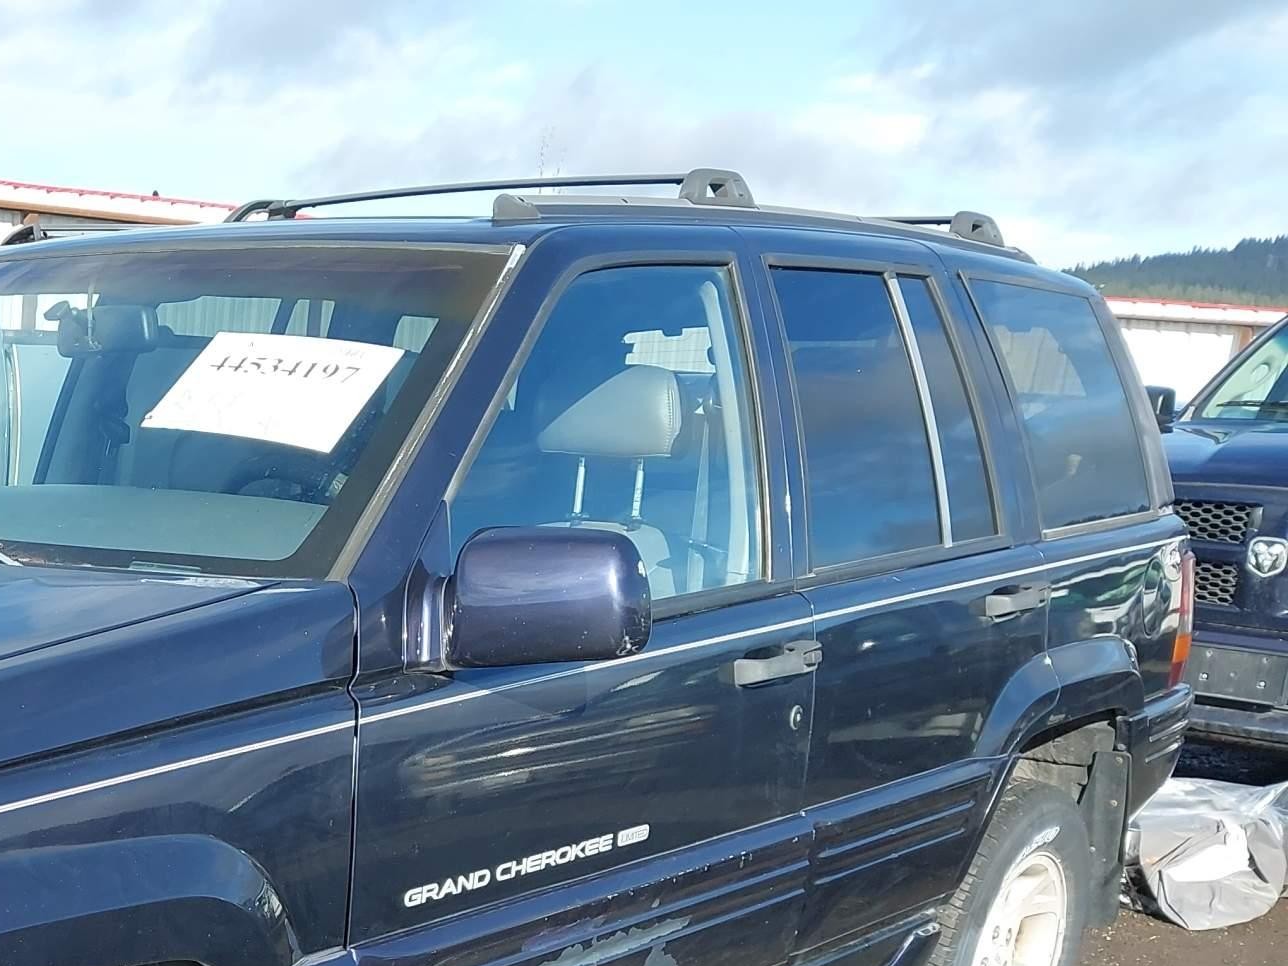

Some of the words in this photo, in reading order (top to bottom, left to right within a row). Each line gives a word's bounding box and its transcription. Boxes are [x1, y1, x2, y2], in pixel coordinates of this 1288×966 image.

[210, 355, 361, 383] 44534197
[404, 868, 491, 908] GRAND
[496, 833, 614, 881] CHEROKEE
[620, 828, 648, 844] LIMITED
